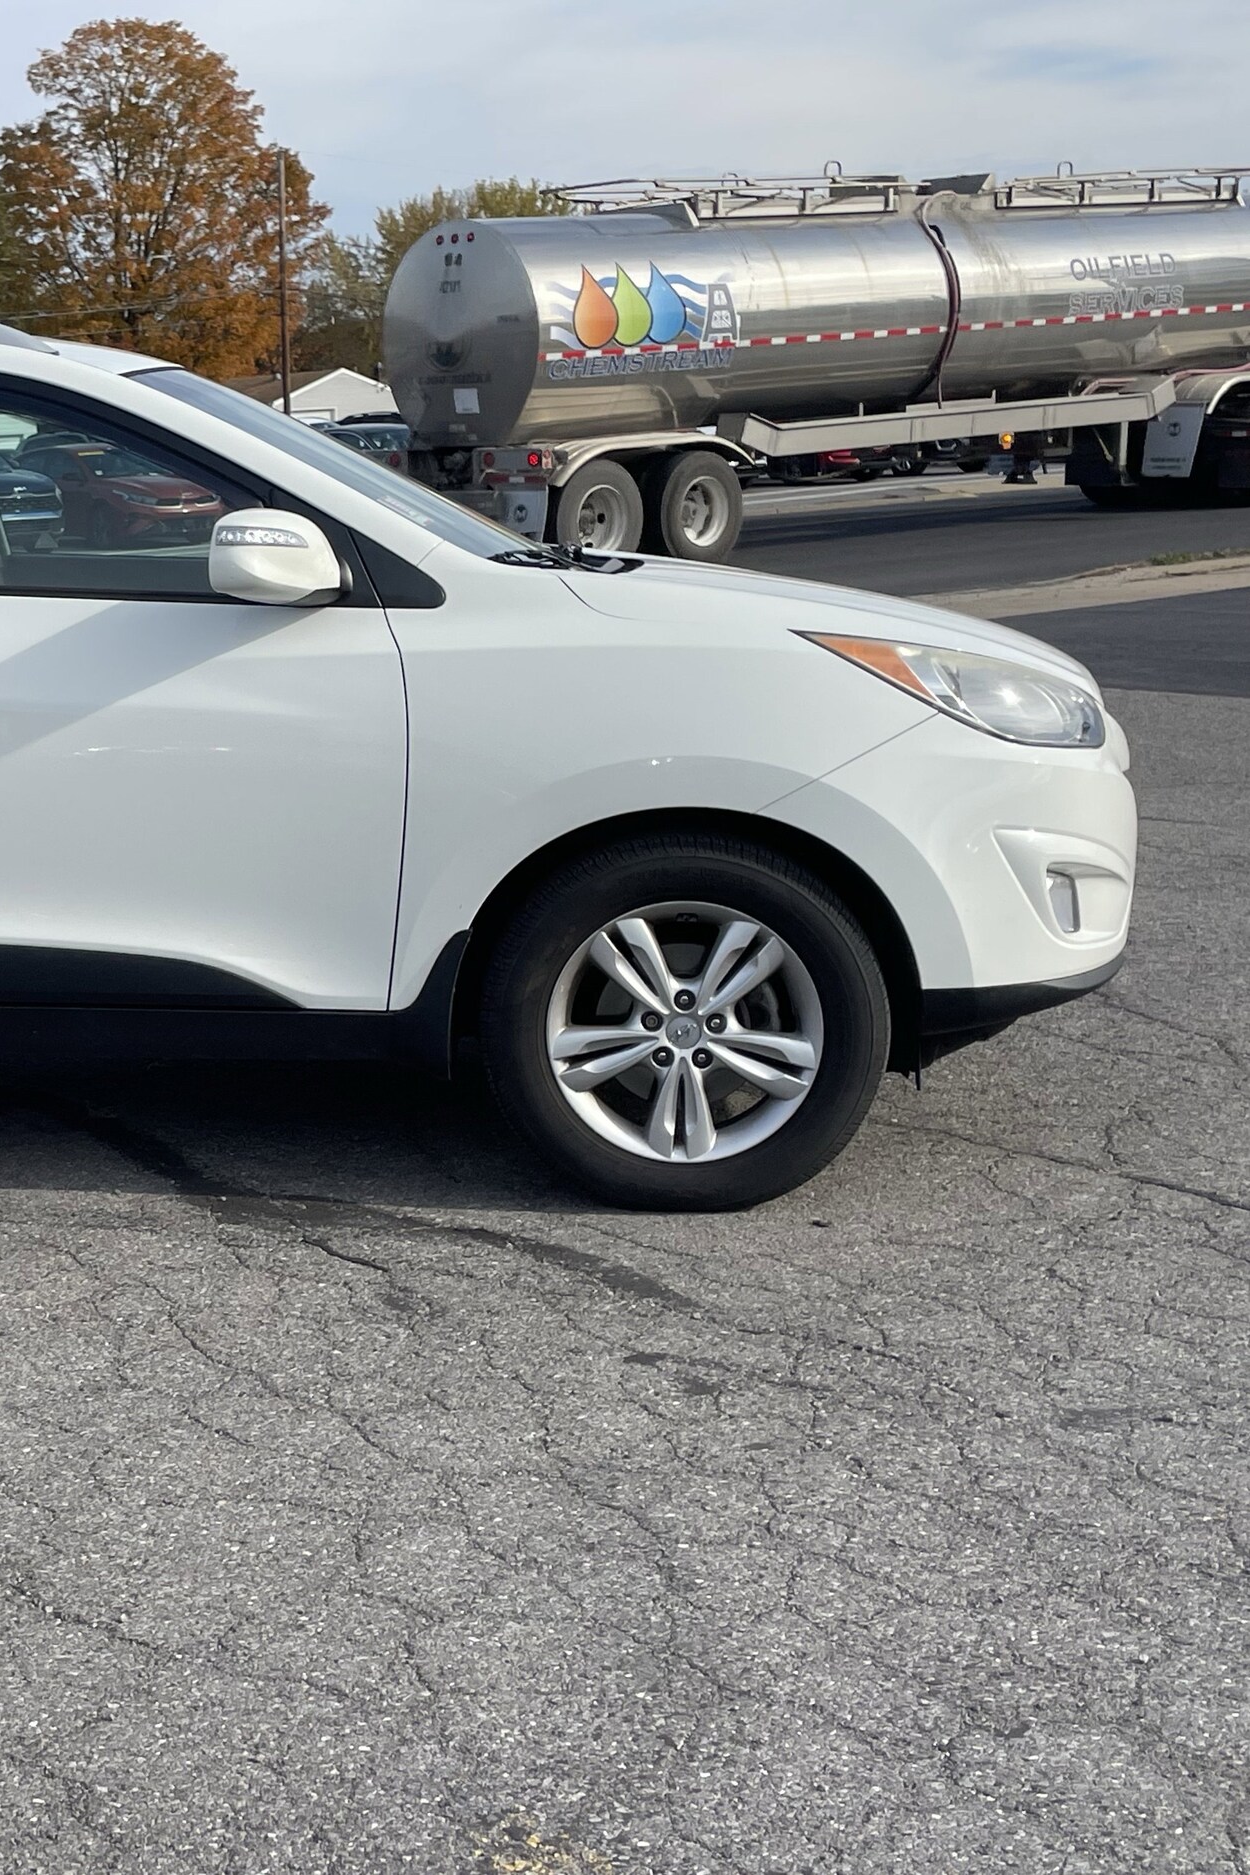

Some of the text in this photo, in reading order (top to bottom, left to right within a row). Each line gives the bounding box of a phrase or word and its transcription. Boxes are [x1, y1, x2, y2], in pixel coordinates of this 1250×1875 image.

[1071, 253, 1176, 280] OILFIELD
[1070, 285, 1184, 314] SERVICES
[550, 348, 734, 380] CHEMSTREAM
